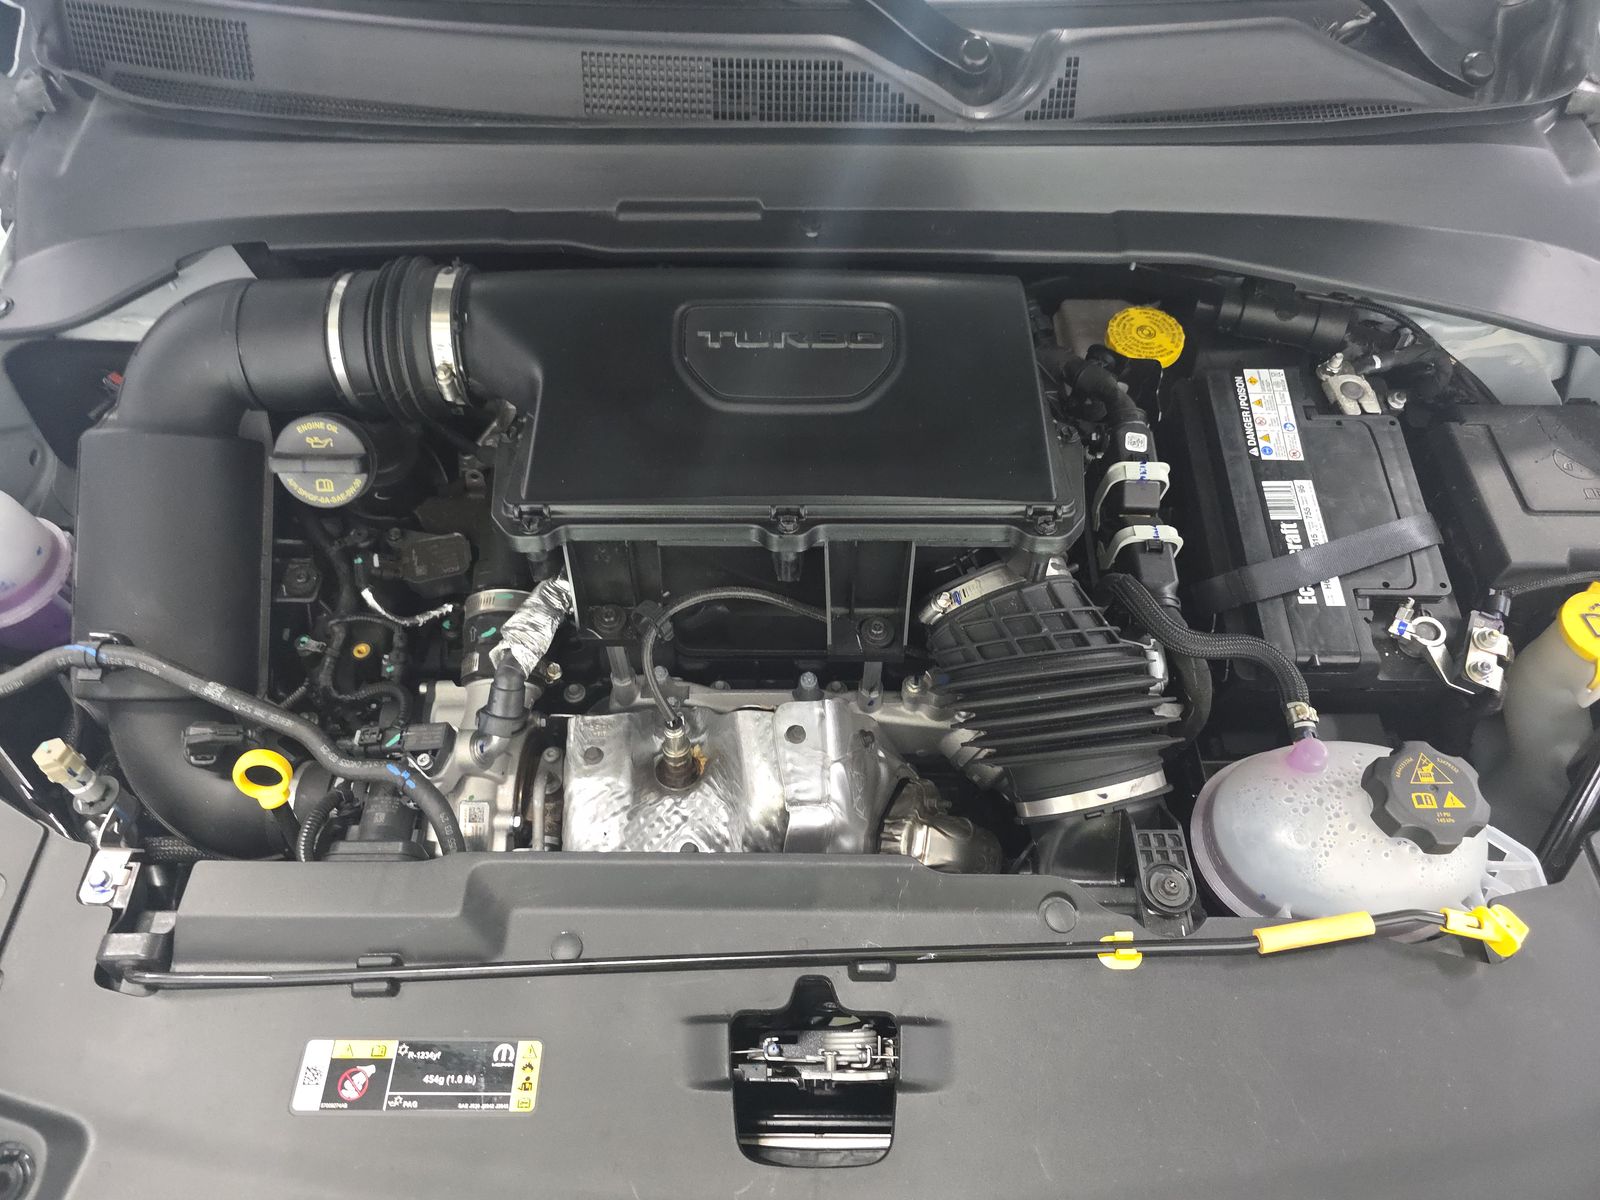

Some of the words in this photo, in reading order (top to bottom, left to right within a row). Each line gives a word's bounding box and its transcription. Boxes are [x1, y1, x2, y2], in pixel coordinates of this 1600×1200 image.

[697, 330, 885, 349] TURBO
[296, 421, 325, 434] ENGINE
[326, 423, 339, 434] OIL
[407, 1050, 442, 1060] R-1234yf
[422, 1074, 445, 1086] 454g
[446, 1074, 463, 1086] (1.0
[464, 1074, 477, 1086] lb)
[402, 1100, 418, 1108] PAG
